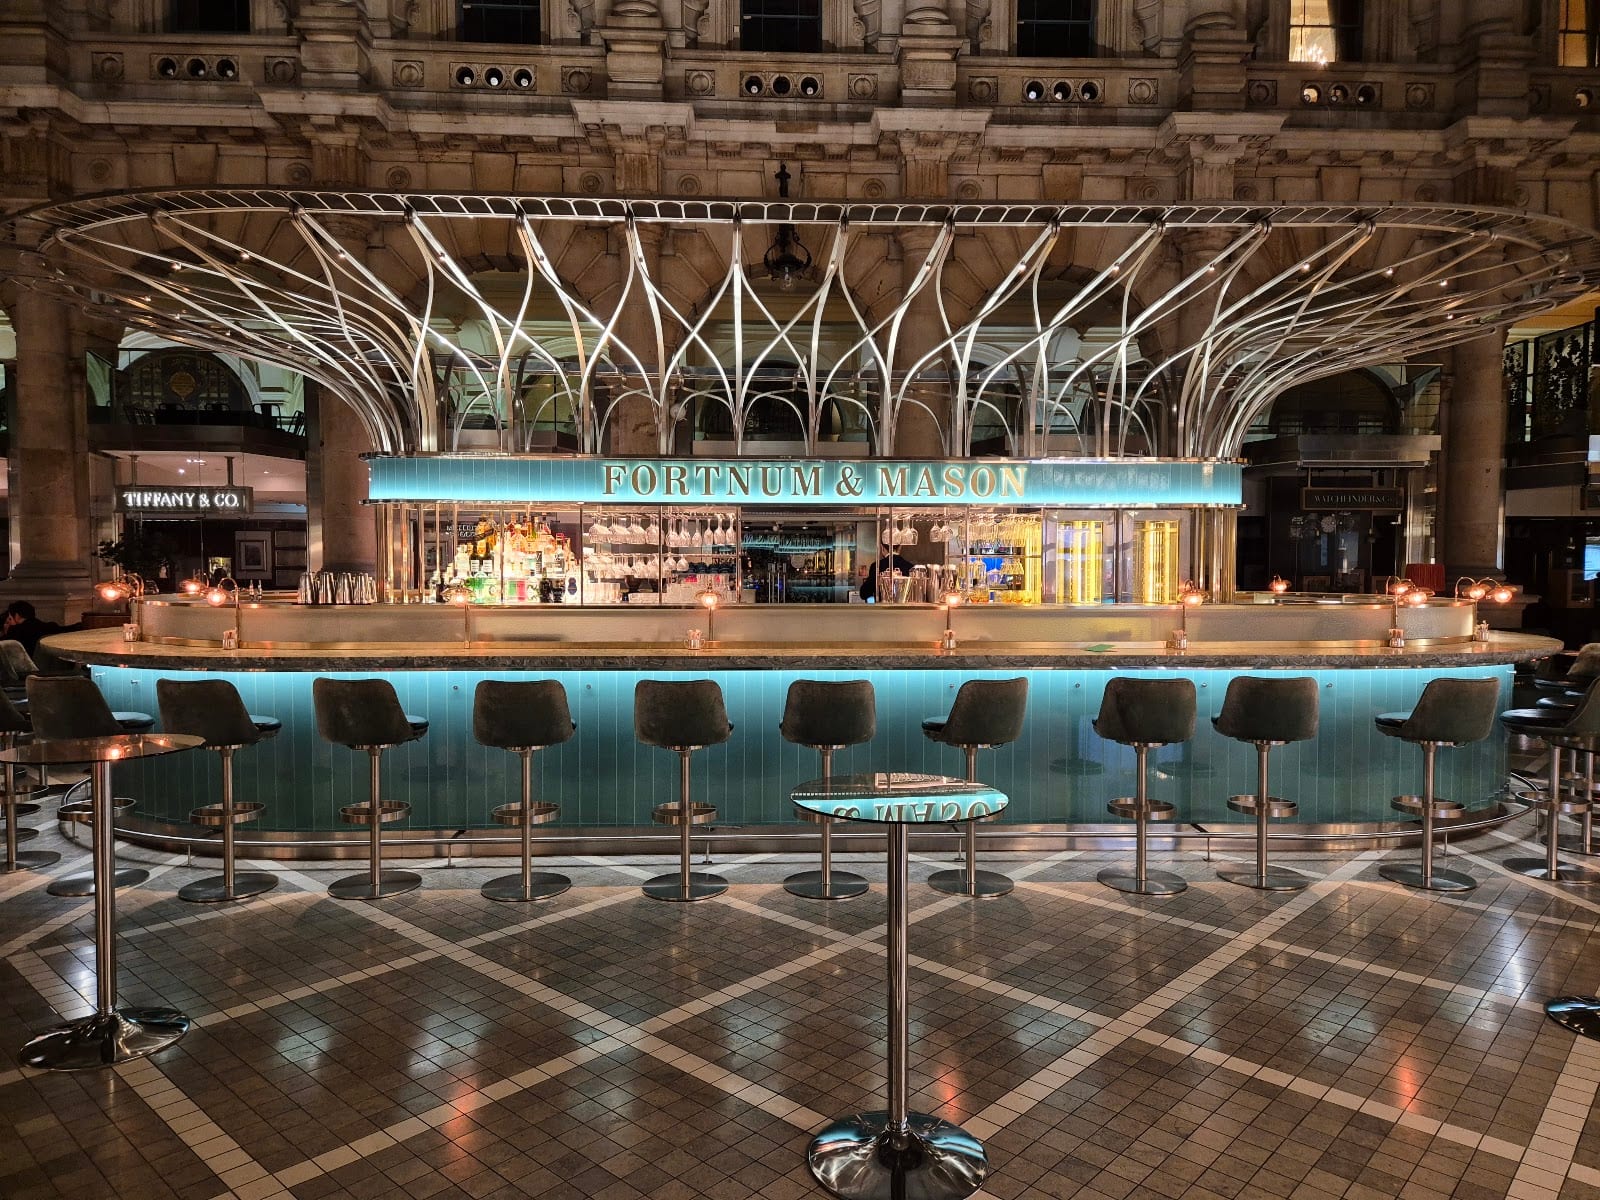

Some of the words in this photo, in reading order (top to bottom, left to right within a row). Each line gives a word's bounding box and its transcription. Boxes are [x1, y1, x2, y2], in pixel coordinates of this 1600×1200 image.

[602, 465, 824, 496] FORTNUM
[836, 466, 864, 497] &
[878, 466, 1028, 497] MASON
[123, 492, 195, 507] TIFFANY
[199, 493, 210, 507] &
[215, 493, 240, 507] CO.
